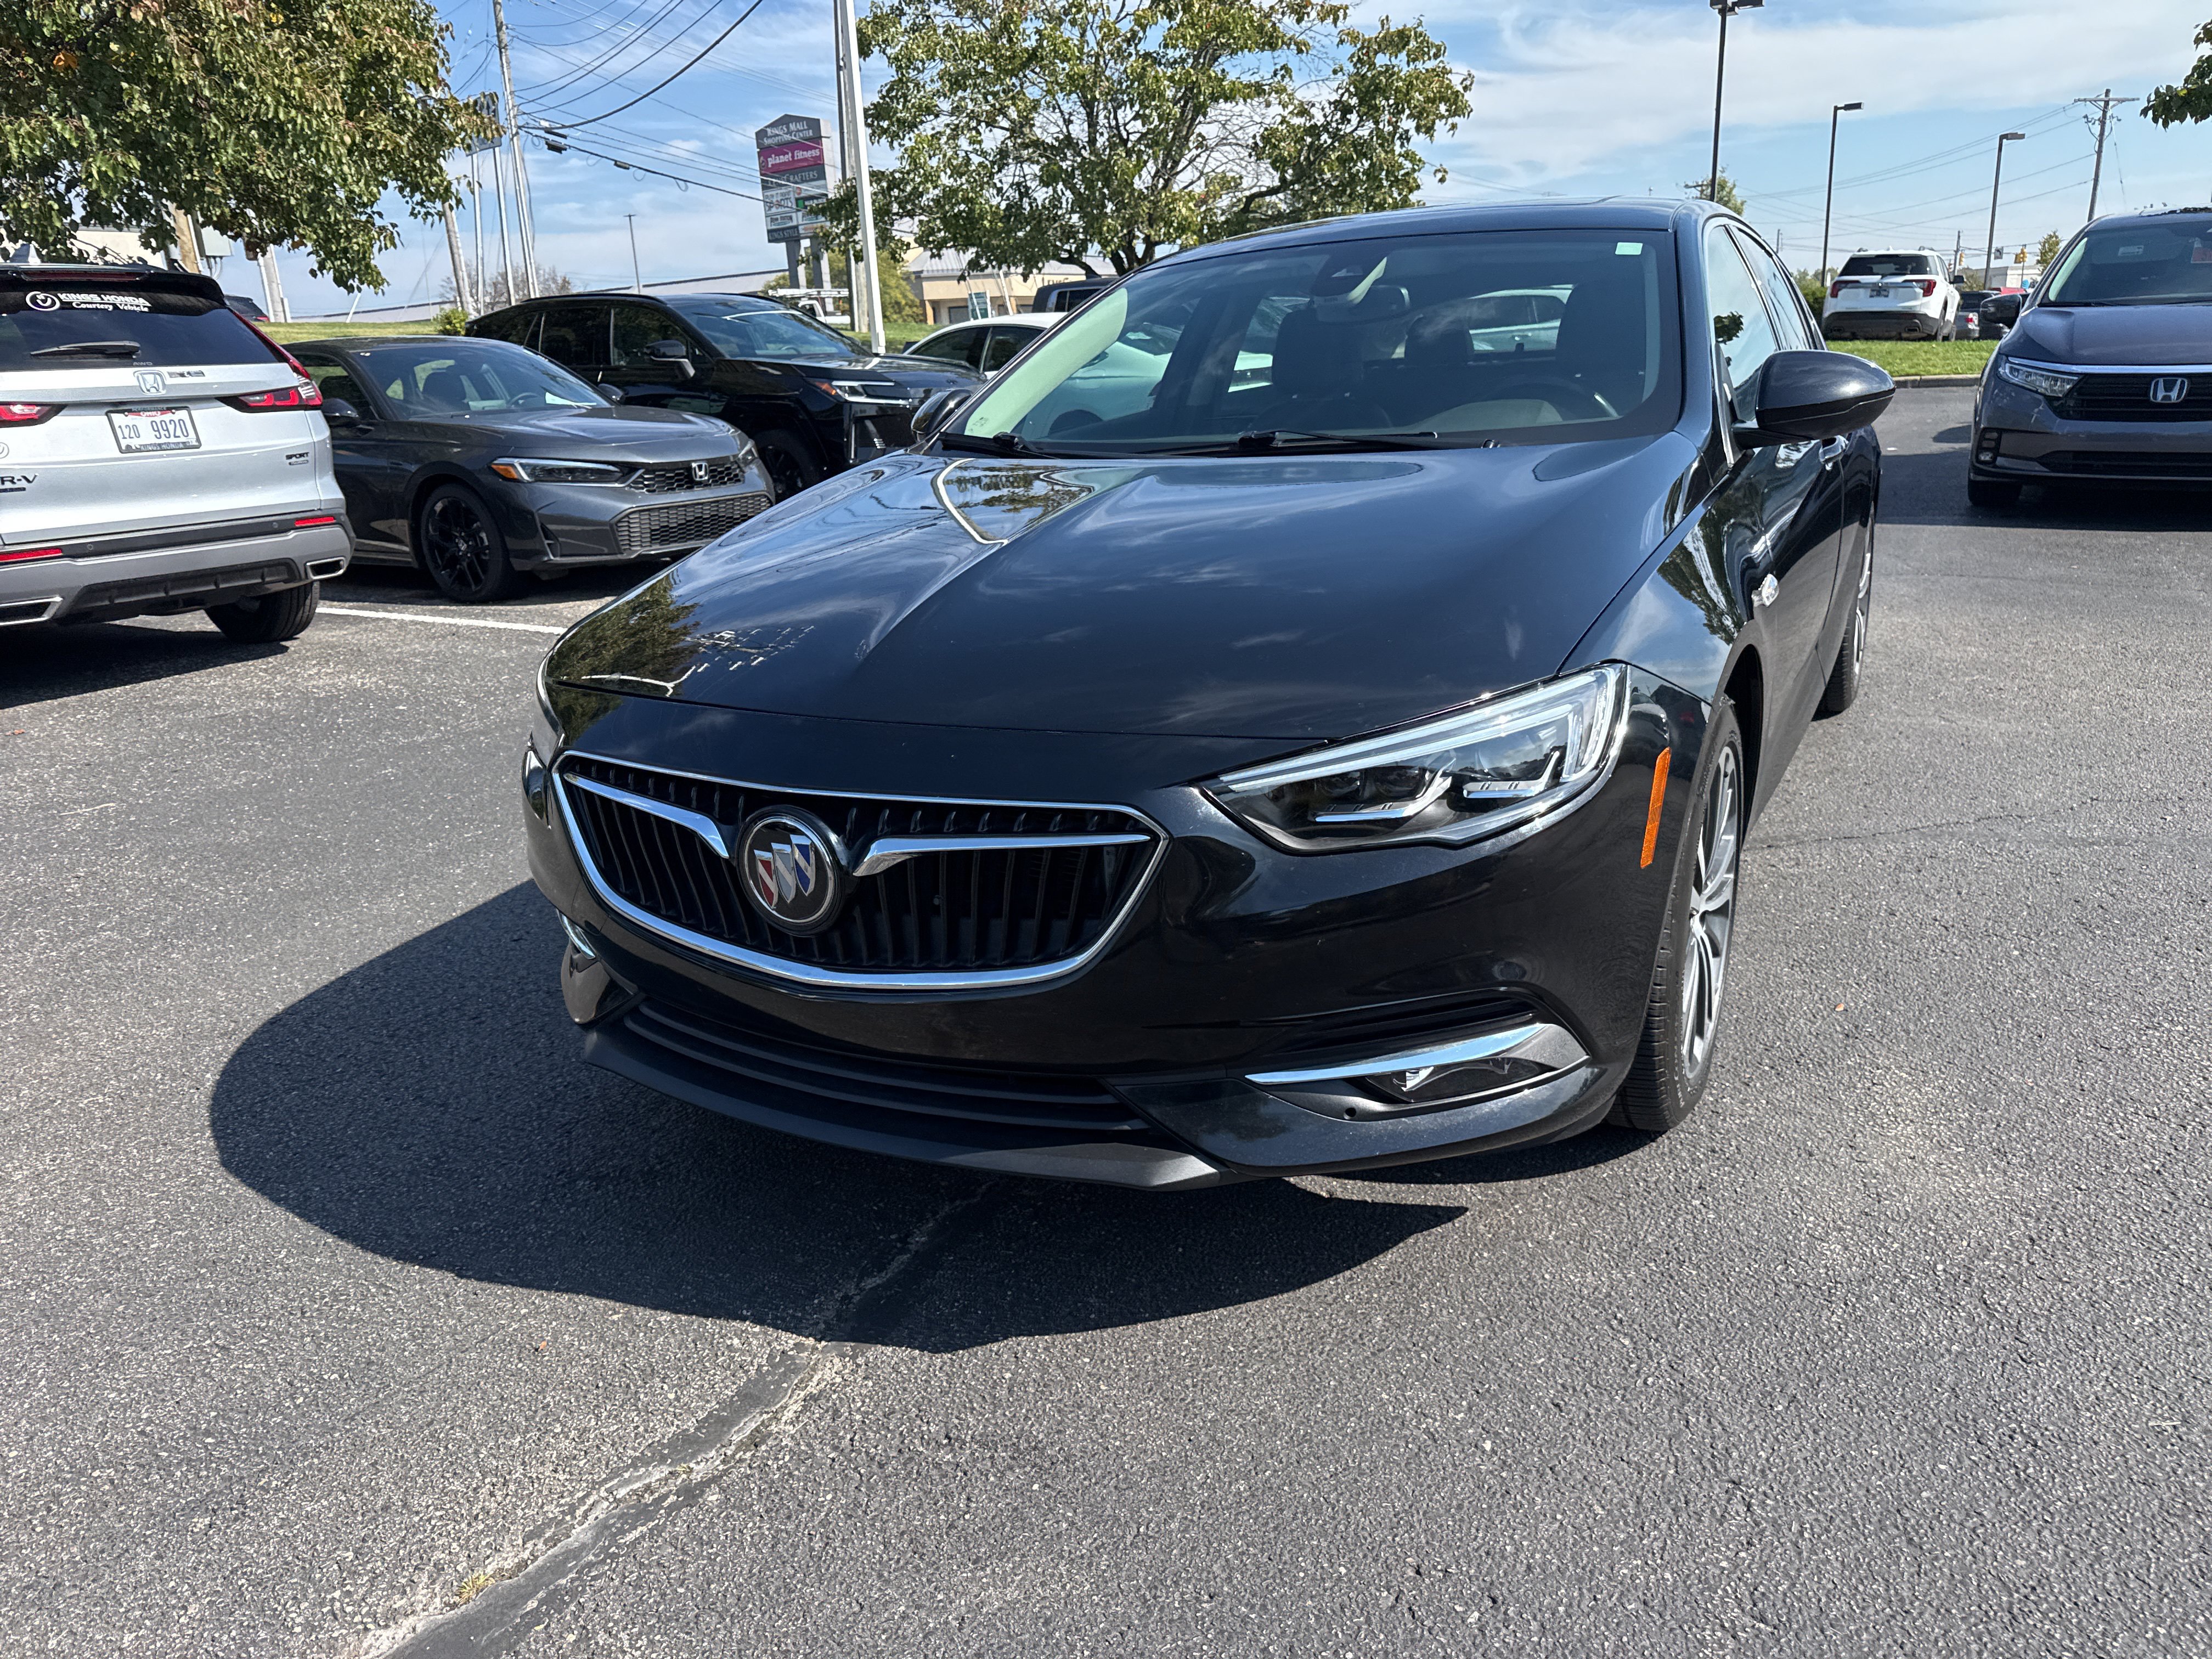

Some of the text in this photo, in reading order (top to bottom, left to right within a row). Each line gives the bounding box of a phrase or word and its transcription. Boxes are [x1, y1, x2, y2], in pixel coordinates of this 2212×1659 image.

[767, 121, 808, 136] KINGS MALL
[768, 148, 820, 167] planet fitness
[72, 301, 150, 312] Courtesy Vehicle
[101, 294, 151, 306] HONDA
[118, 419, 189, 439] 120 9920
